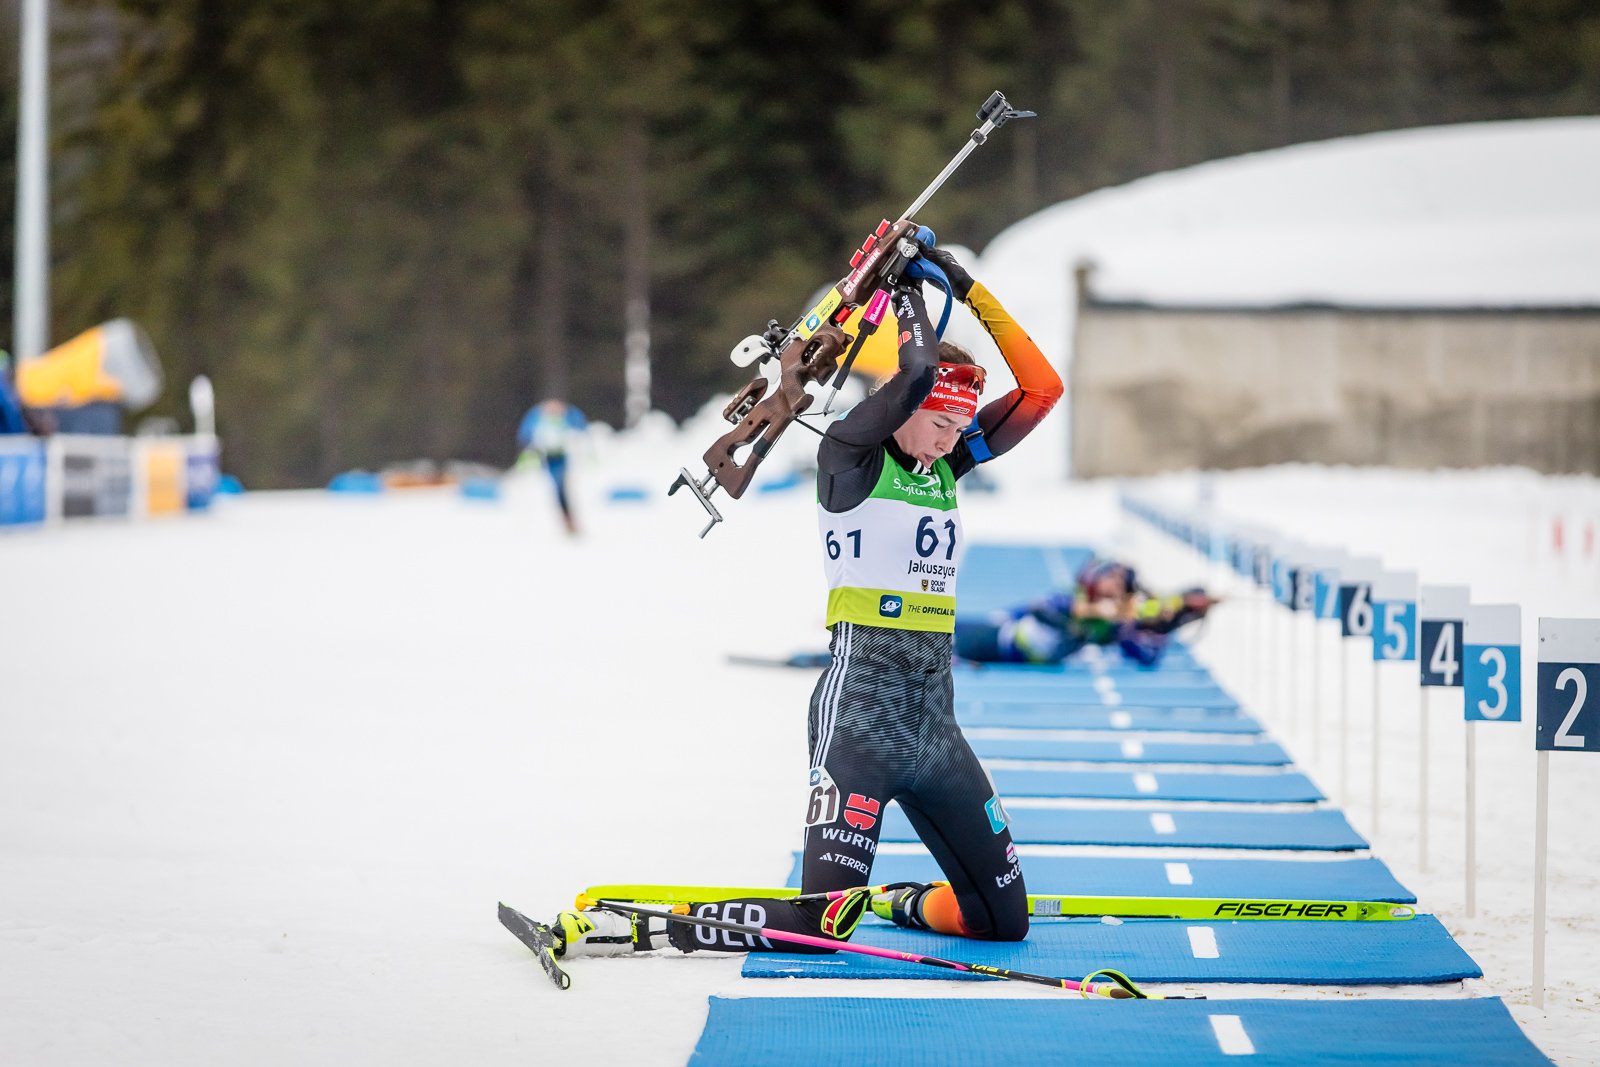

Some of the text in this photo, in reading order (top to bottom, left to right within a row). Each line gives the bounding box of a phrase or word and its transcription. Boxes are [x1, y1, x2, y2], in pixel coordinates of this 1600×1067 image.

[826, 529, 861, 561] 61
[914, 515, 957, 560] 61
[908, 560, 956, 579] Jakuszyce
[908, 605, 921, 613] THE
[922, 606, 949, 616] OFFICIAL
[1316, 571, 1340, 619] 7
[1347, 582, 1374, 636] 6
[1381, 602, 1408, 660] 5
[1430, 622, 1459, 686] 4
[1478, 647, 1508, 720] 3
[1554, 667, 1588, 748] 2
[806, 784, 837, 825] 61
[822, 828, 877, 856] WÜRTH
[834, 853, 869, 876] TERREX
[995, 862, 1021, 888] tect
[695, 902, 774, 949] GER
[1214, 903, 1348, 918] FISCHER
